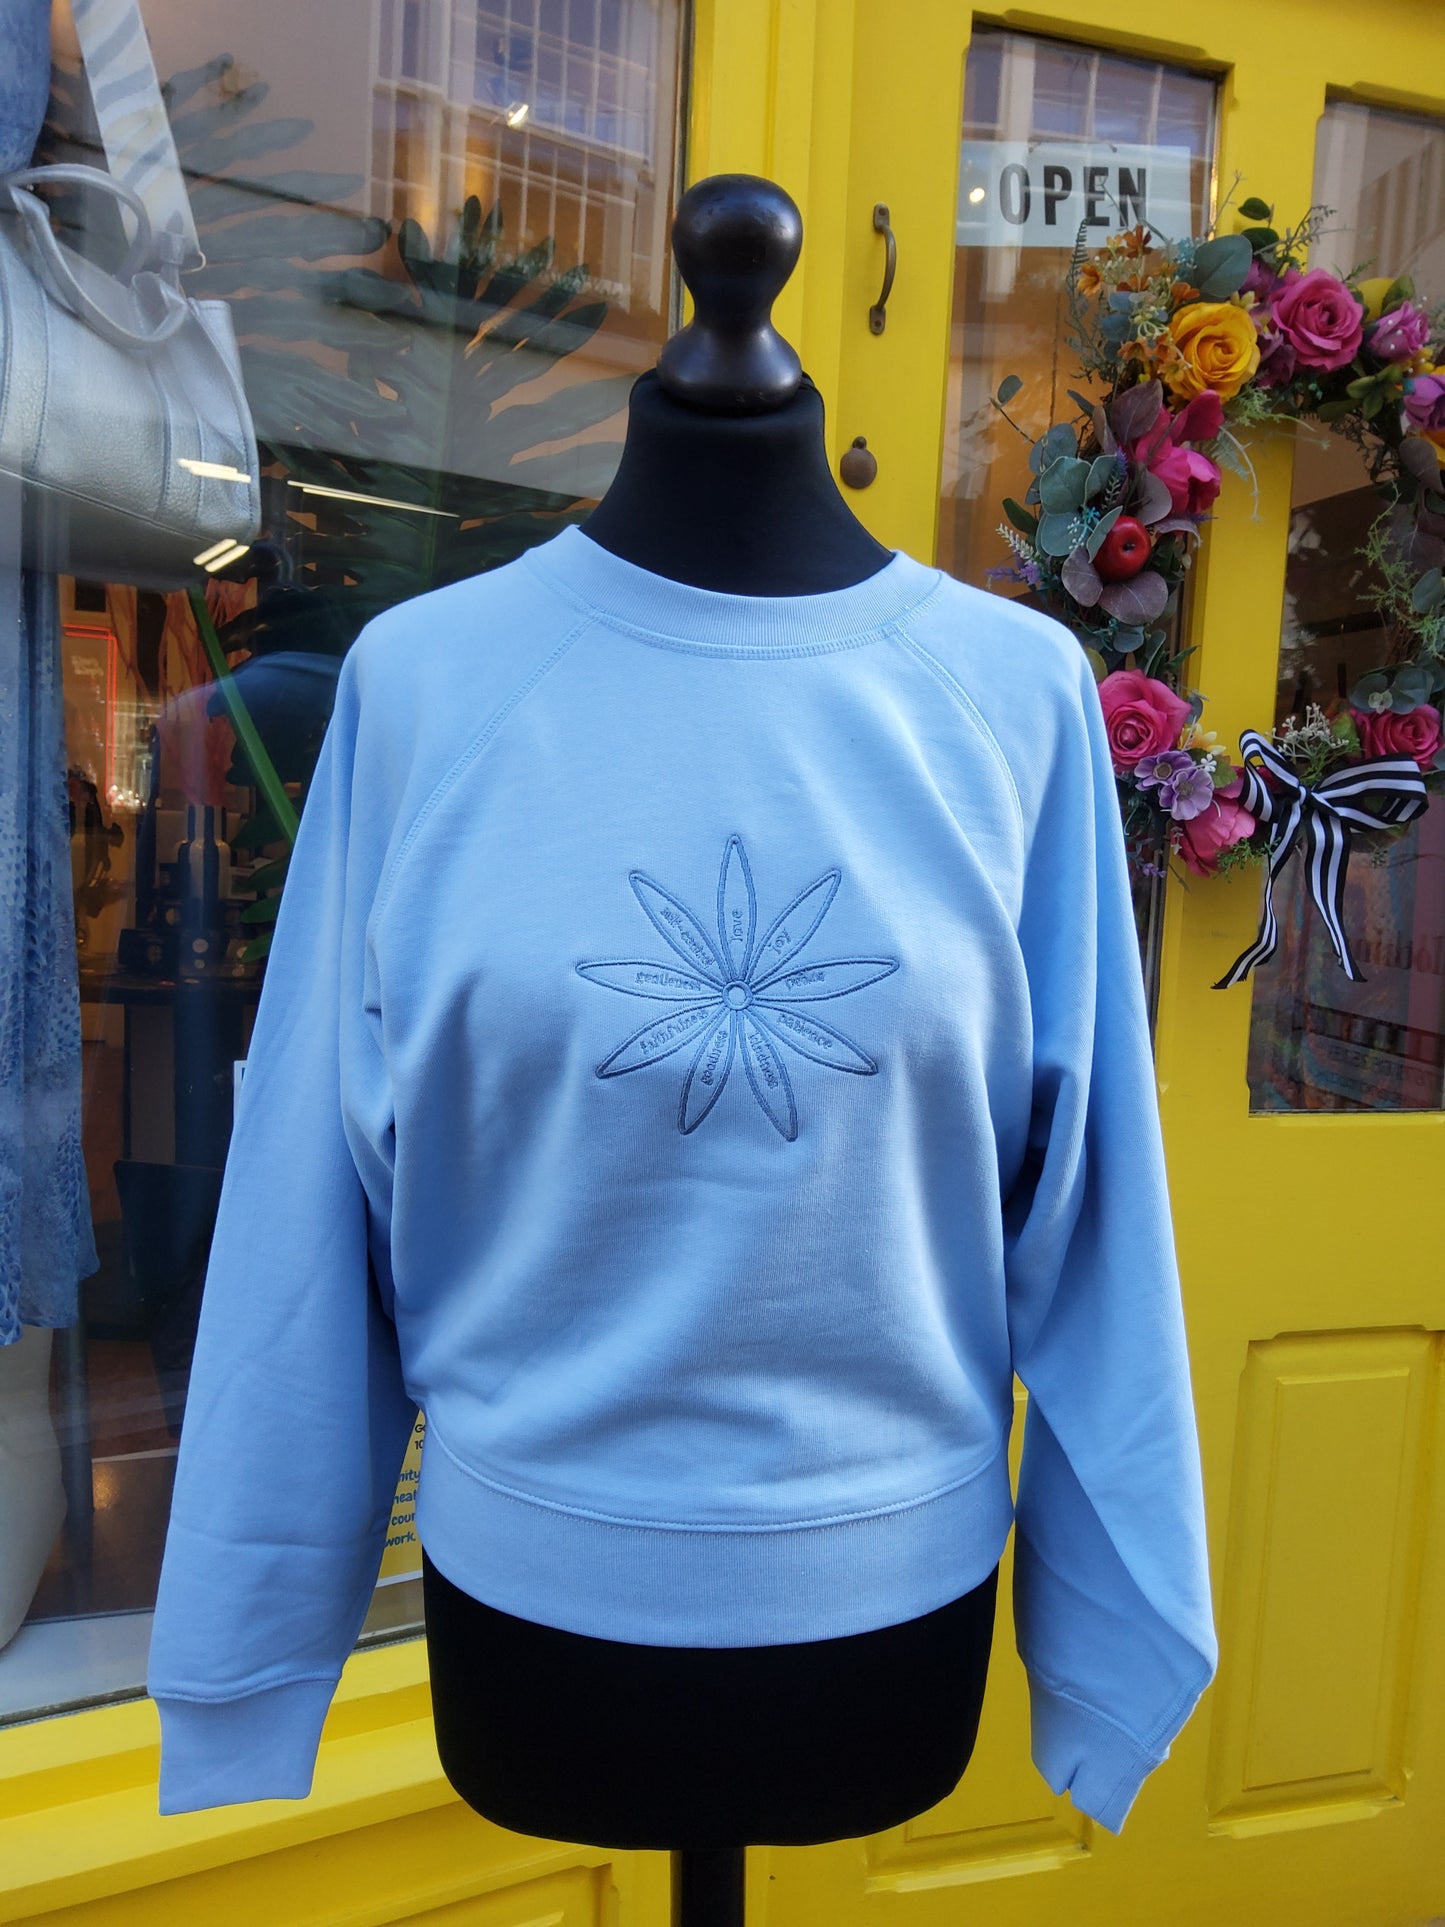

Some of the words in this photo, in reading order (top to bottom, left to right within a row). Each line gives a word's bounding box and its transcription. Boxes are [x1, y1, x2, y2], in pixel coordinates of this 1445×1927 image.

[1000, 163, 1146, 227] OPEN
[730, 909, 743, 942] love
[766, 927, 791, 955] joy
[635, 972, 701, 991] gentleness
[785, 971, 825, 992] peace
[640, 1009, 708, 1055] faithfulness
[778, 1013, 834, 1050] patience
[700, 1030, 728, 1086] goodness
[748, 1032, 779, 1089] kindness
